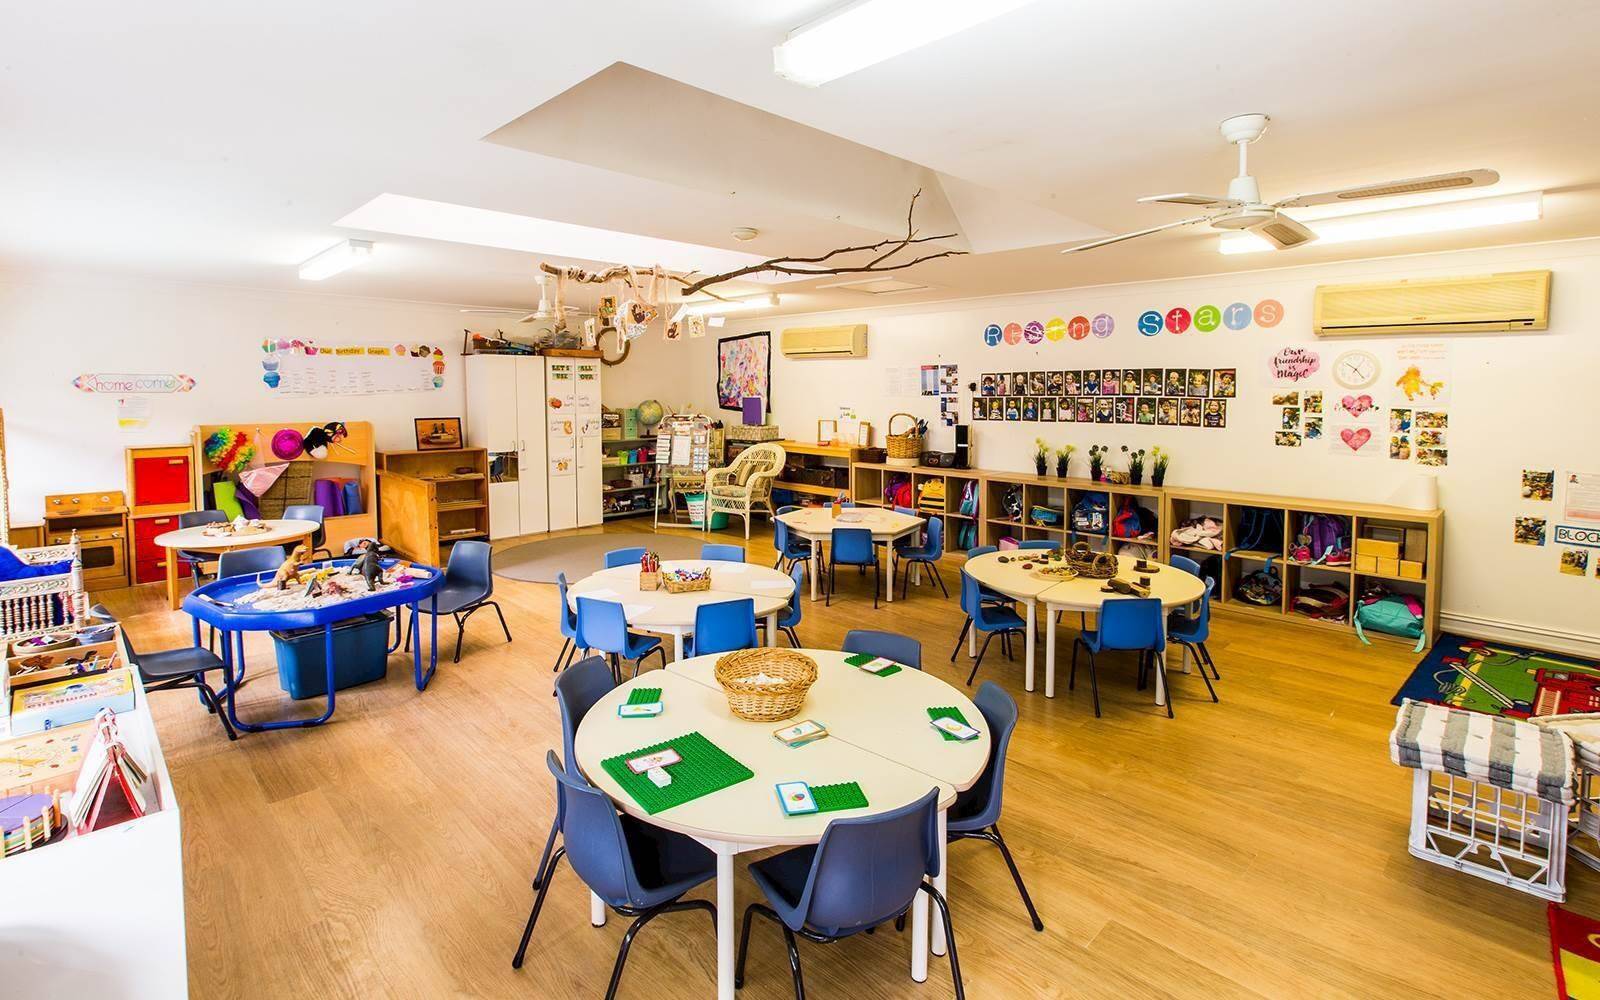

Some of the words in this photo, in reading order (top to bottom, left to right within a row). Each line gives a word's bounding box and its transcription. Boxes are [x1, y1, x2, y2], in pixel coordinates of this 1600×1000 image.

[985, 313, 1114, 346] Rising
[1139, 300, 1283, 336] Stars
[1283, 348, 1304, 357] Our
[1274, 356, 1316, 368] friendship
